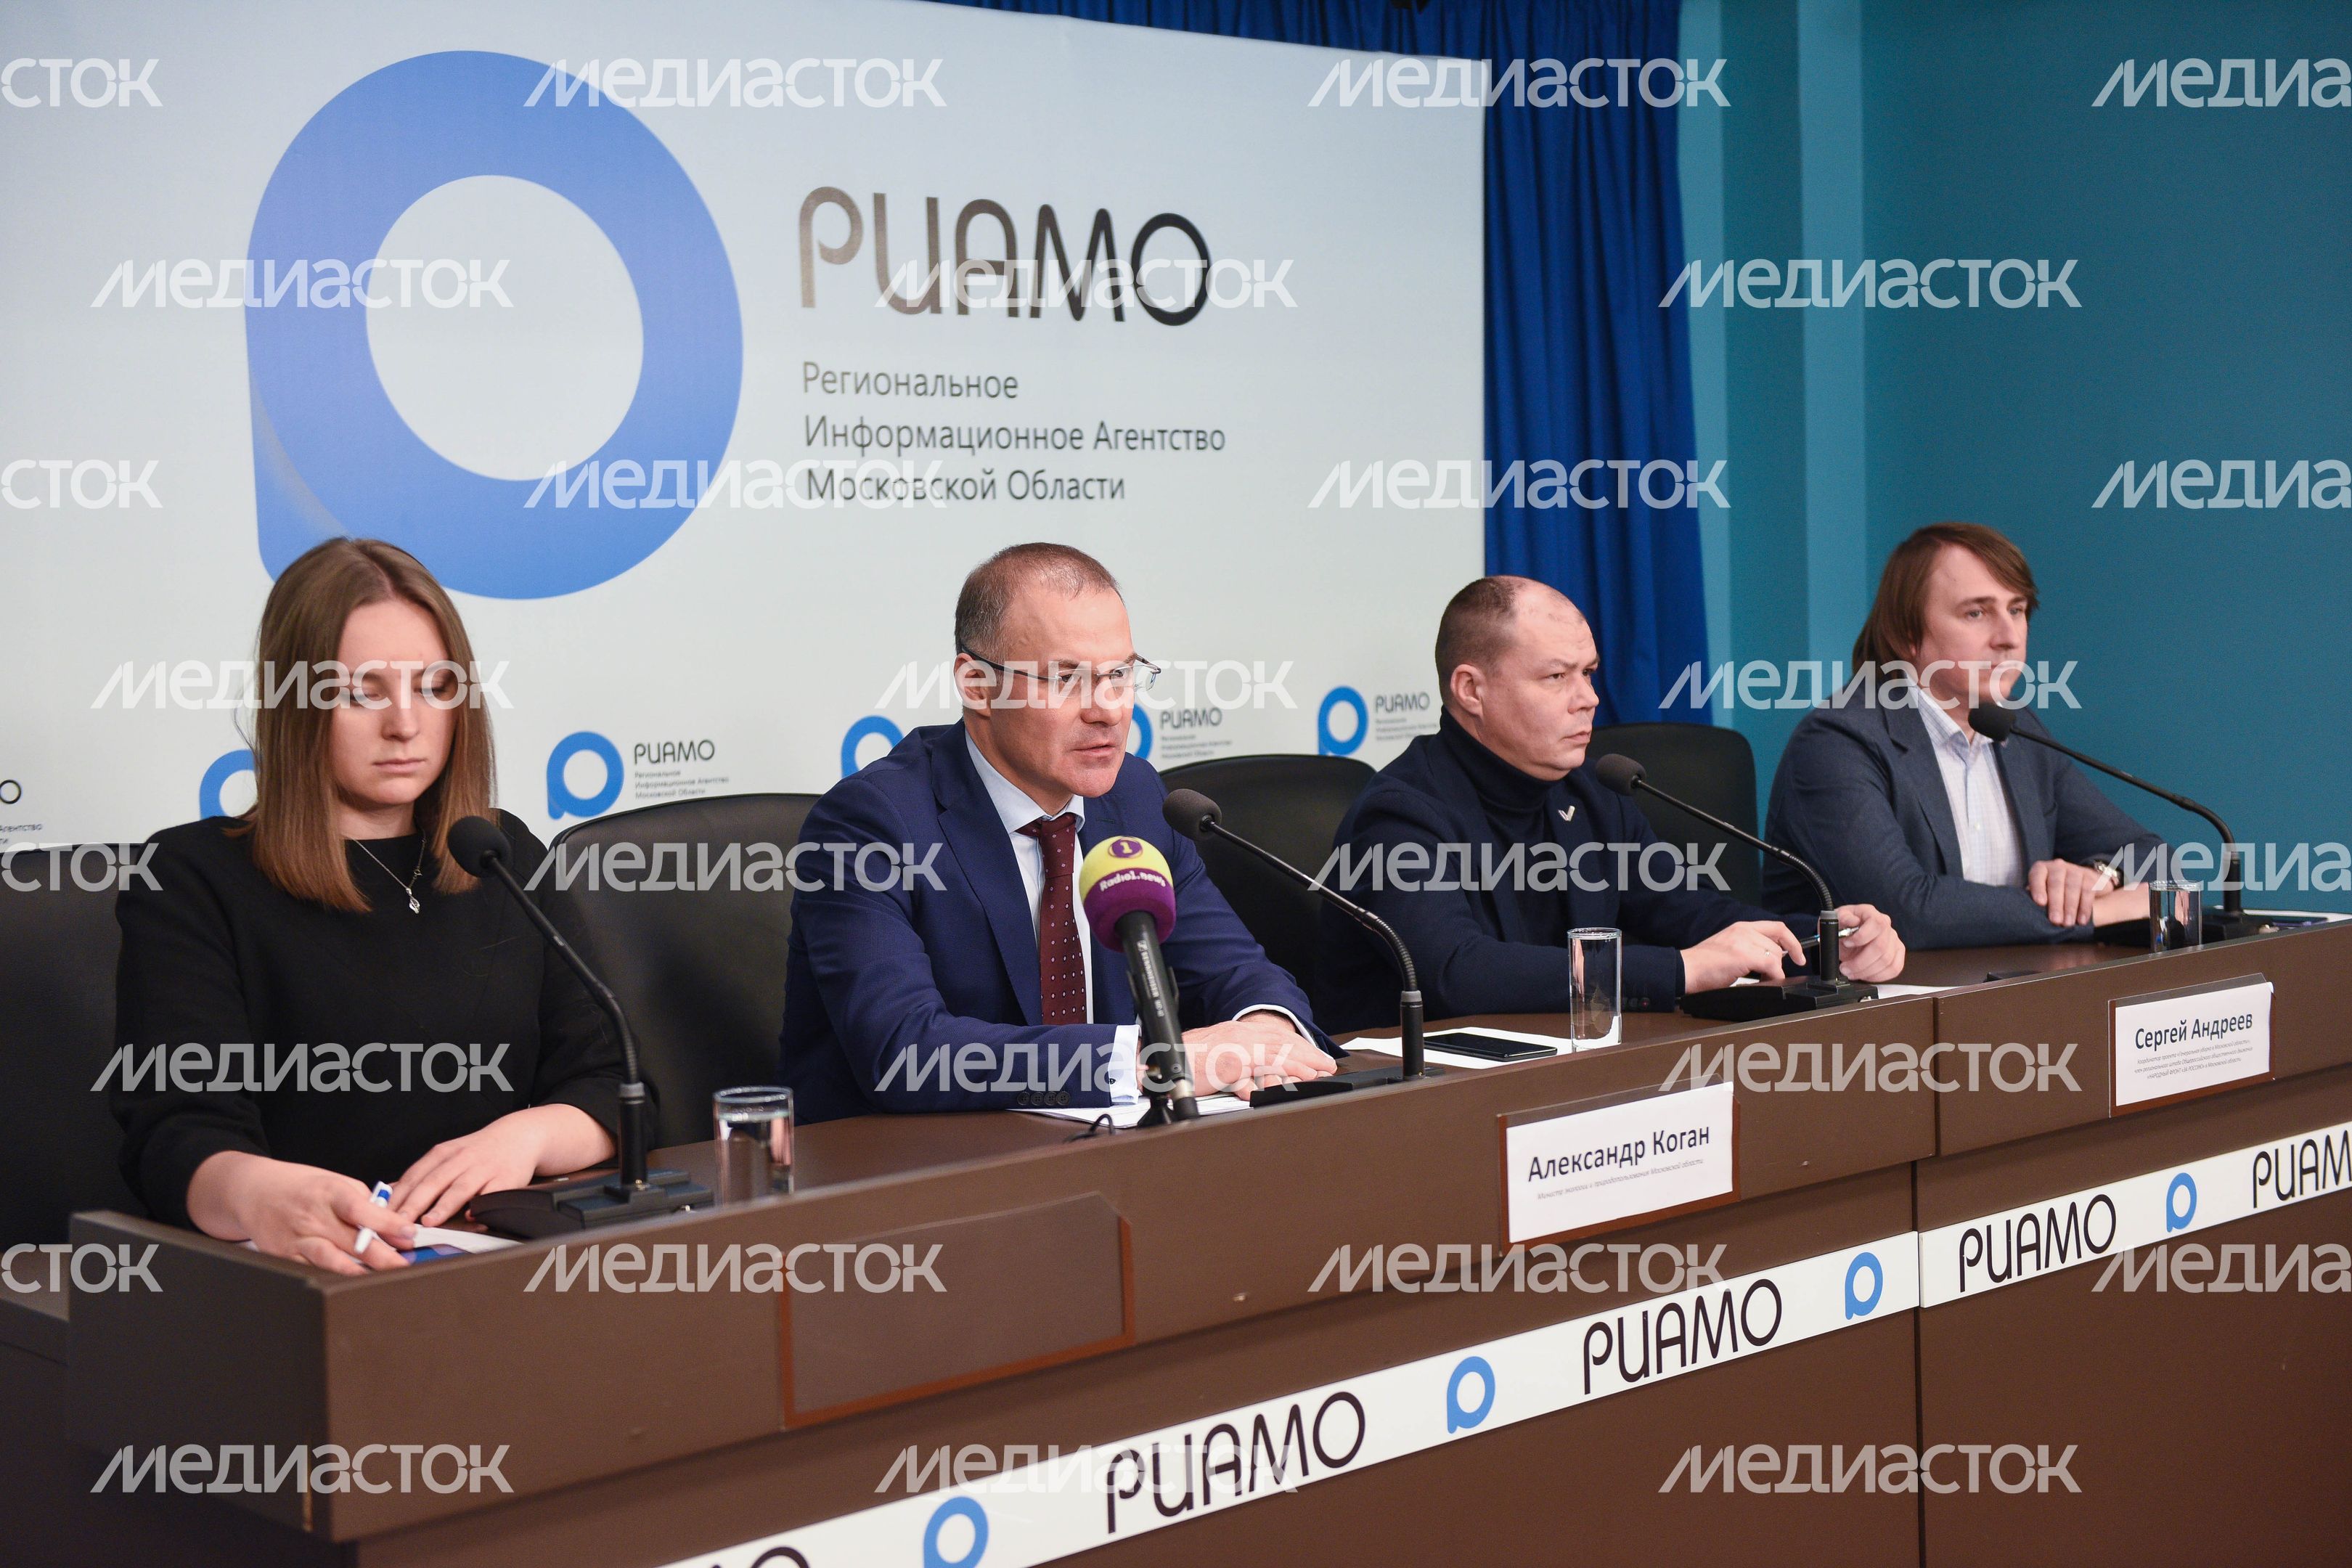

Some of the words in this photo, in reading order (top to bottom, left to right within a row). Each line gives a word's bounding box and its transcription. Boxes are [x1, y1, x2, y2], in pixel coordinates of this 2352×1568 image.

[799, 186, 1212, 327] РИАМО
[803, 362, 1019, 399] Региональное
[805, 415, 1085, 457] Информационное
[1093, 421, 1226, 452] Агентство
[807, 467, 997, 502] Московской
[1007, 469, 1125, 500] Области
[1160, 707, 1222, 730] РИАМО
[1376, 692, 1431, 714] РИАМО
[634, 739, 715, 765] РИАМО
[1119, 841, 1133, 854] 1
[1099, 870, 1166, 892] Radio1.news
[2135, 1019, 2187, 1052] Сергей
[2191, 1013, 2253, 1040] Андреев
[1528, 1140, 1646, 1182] Александр
[1653, 1127, 1710, 1155] Коган
[1959, 1193, 2117, 1293] РИАМО
[1583, 1278, 1782, 1395] РИАМО
[1106, 1391, 1365, 1534] РИАМО
